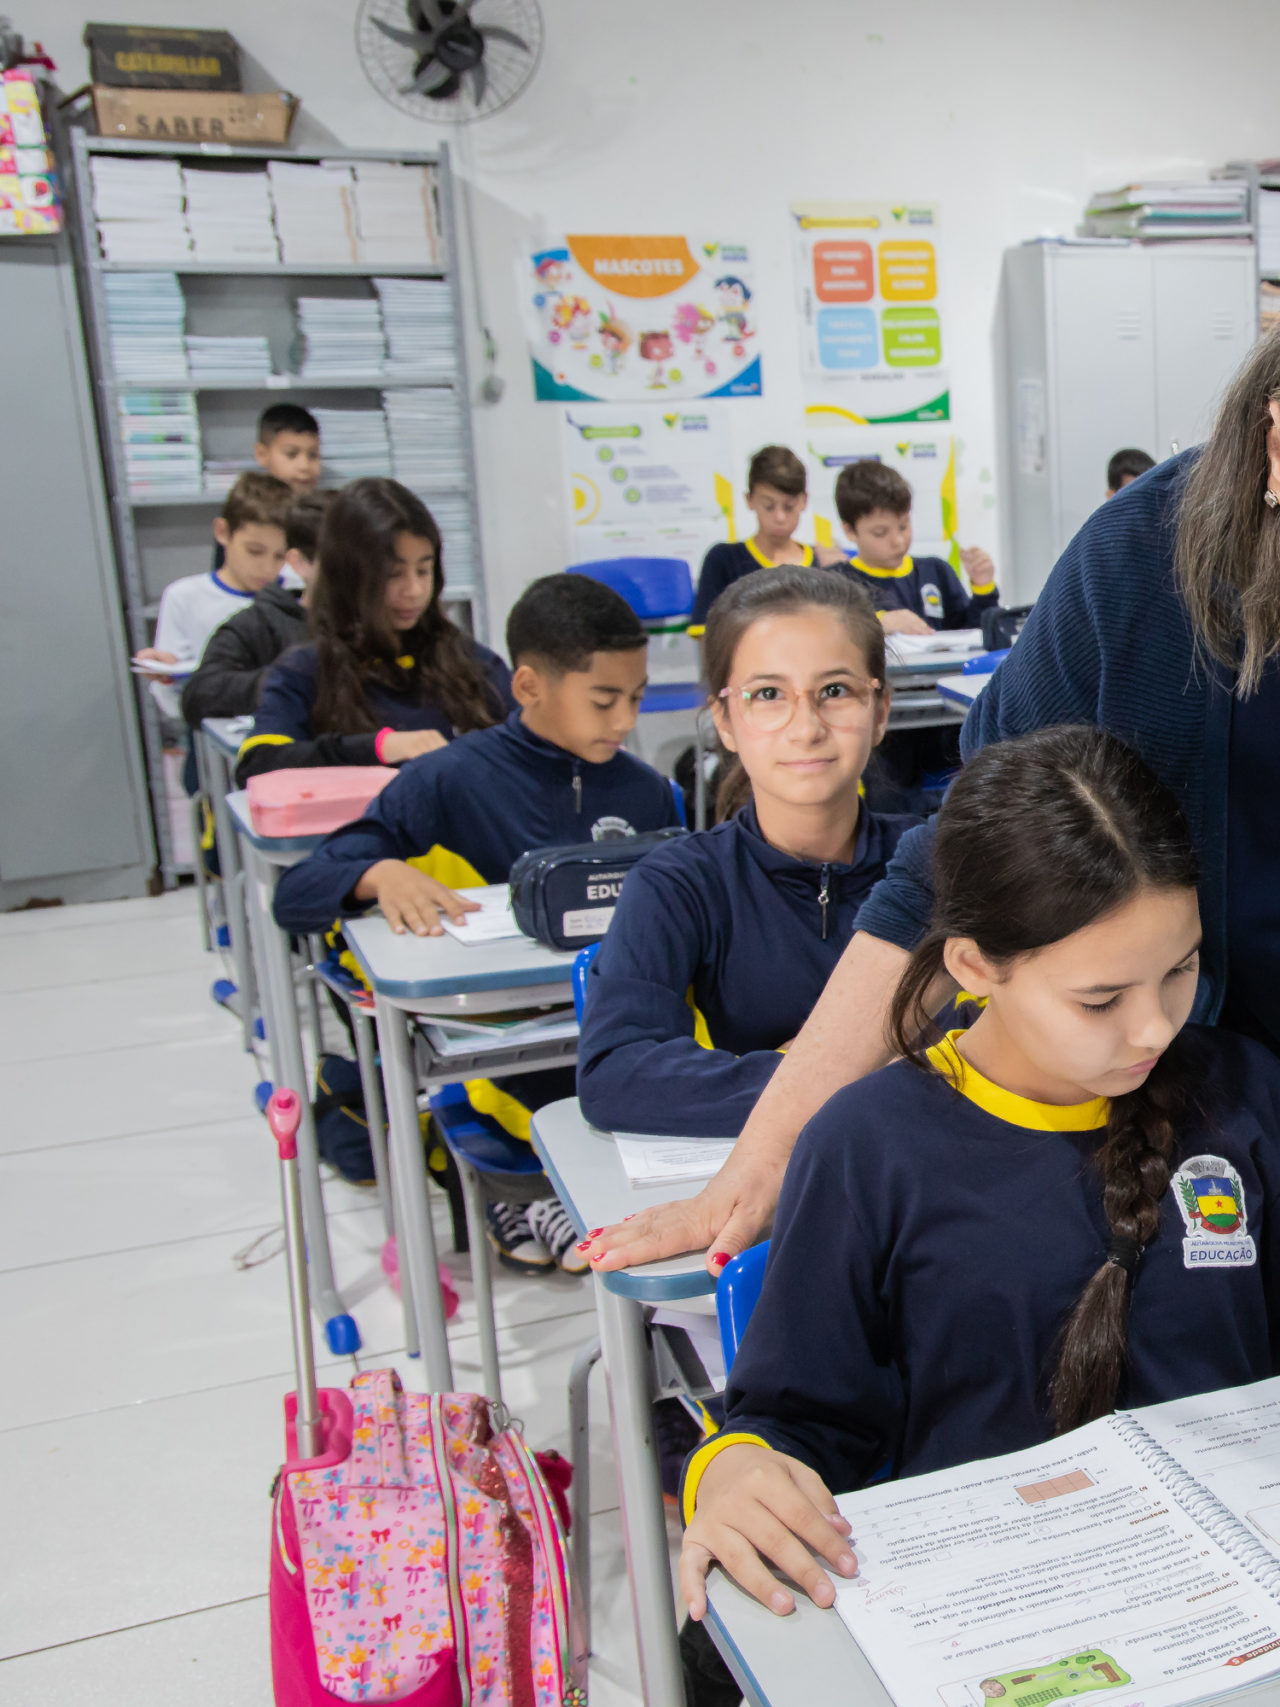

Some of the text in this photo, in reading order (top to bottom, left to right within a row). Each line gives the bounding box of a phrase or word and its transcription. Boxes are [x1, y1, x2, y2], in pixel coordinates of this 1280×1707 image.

[115, 51, 221, 77] CATERPILLAR
[136, 114, 225, 138] SABER
[593, 258, 684, 276] MASCOTES
[1190, 1247, 1253, 1262] EDUCAÇÃO
[1113, 1508, 1144, 1521] terreno
[1127, 1507, 1170, 1526] Responda
[1070, 1522, 1103, 1534] fazenda
[1143, 1524, 1171, 1536] cabem
[1138, 1531, 1170, 1544] preciso
[1164, 1538, 1184, 1547] Para
[1071, 1532, 1144, 1558] aproximadamente
[1103, 1541, 1141, 1556] descobrir
[1134, 1545, 1166, 1558] calcular
[1068, 1551, 1104, 1565] quantos
[1108, 1556, 1127, 1565] área
[1136, 1545, 1192, 1567] comprimento
[1172, 1558, 1192, 1567] área
[1025, 1560, 1070, 1576] quadrados
[1059, 1561, 1109, 1579] aproximada
[1109, 1564, 1132, 1575] igual
[984, 1578, 1007, 1588] lados
[1013, 1579, 1048, 1591] fazenda
[1106, 1571, 1146, 1587] quadrado
[1173, 1571, 1217, 1589] dimensões
[1199, 1576, 1222, 1587] Qual
[945, 1584, 984, 1598] medindo
[1017, 1583, 1065, 1601] quilômetro
[1063, 1589, 1087, 1599] lados
[1086, 1584, 1105, 1592] com
[1183, 1579, 1241, 1604] Compreenda
[951, 1590, 999, 1607] quilômetro
[1025, 1596, 1064, 1610] medindo
[1124, 1589, 1162, 1604] fazenda?
[1152, 1589, 1187, 1603] unidade
[969, 1607, 1017, 1625] quilômetro
[1109, 1603, 1142, 1615] medida
[1040, 1613, 1098, 1635] comprimento
[1123, 1604, 1240, 1647] aproximada dessa fazenda?
[1229, 1617, 1252, 1629] Qual
[1005, 1631, 1041, 1644] utilizada
[1169, 1631, 1190, 1640] área
[1242, 1632, 1279, 1649] Observe
[983, 1639, 1004, 1649] para
[1150, 1632, 1205, 1654] quilômetros
[1178, 1626, 1273, 1663] fazenda Cavalo Alado.
[954, 1646, 985, 1658] indicar
[1212, 1649, 1236, 1660] vista
[1173, 1655, 1213, 1672] superior
